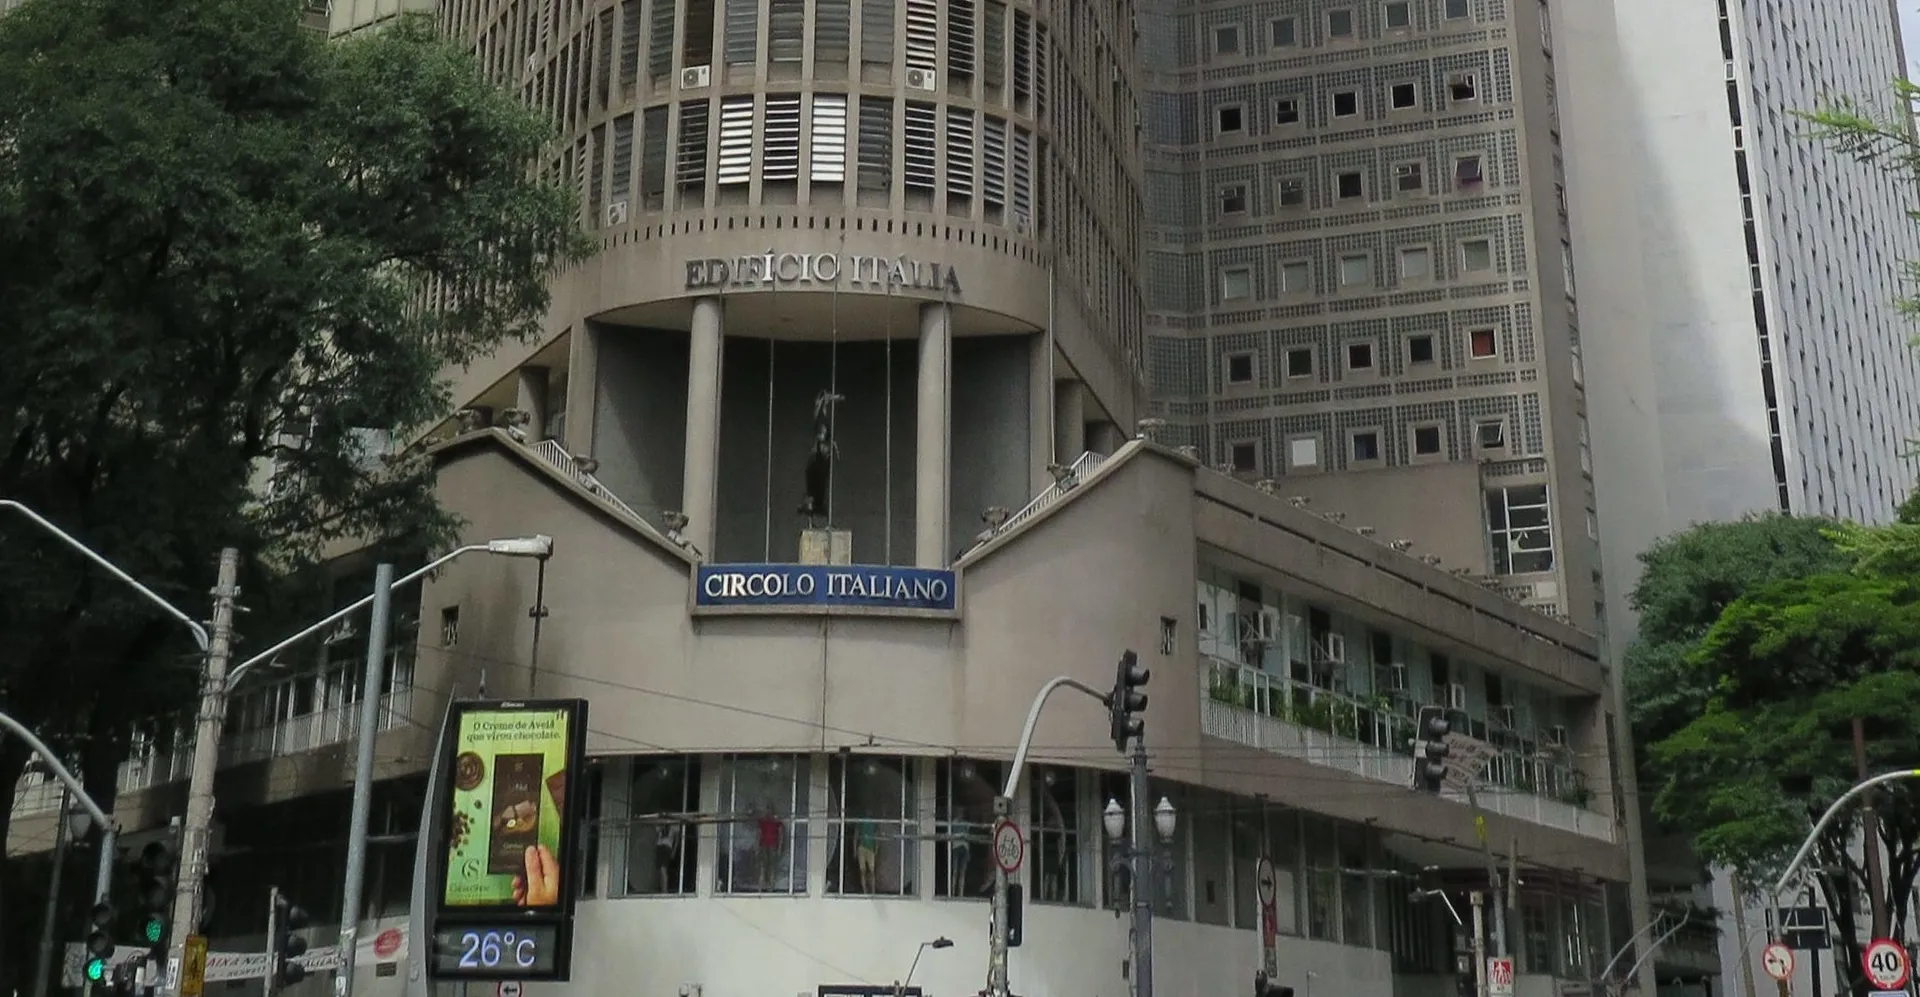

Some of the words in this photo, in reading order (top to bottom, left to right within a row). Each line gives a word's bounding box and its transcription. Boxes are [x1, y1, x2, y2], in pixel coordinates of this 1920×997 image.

[685, 247, 841, 289] EDIFÍCIO
[851, 252, 963, 294] ITÁLIA
[704, 573, 816, 597] CIRCOLO
[826, 573, 948, 601] ITALIANO
[1871, 951, 1898, 972] 40
